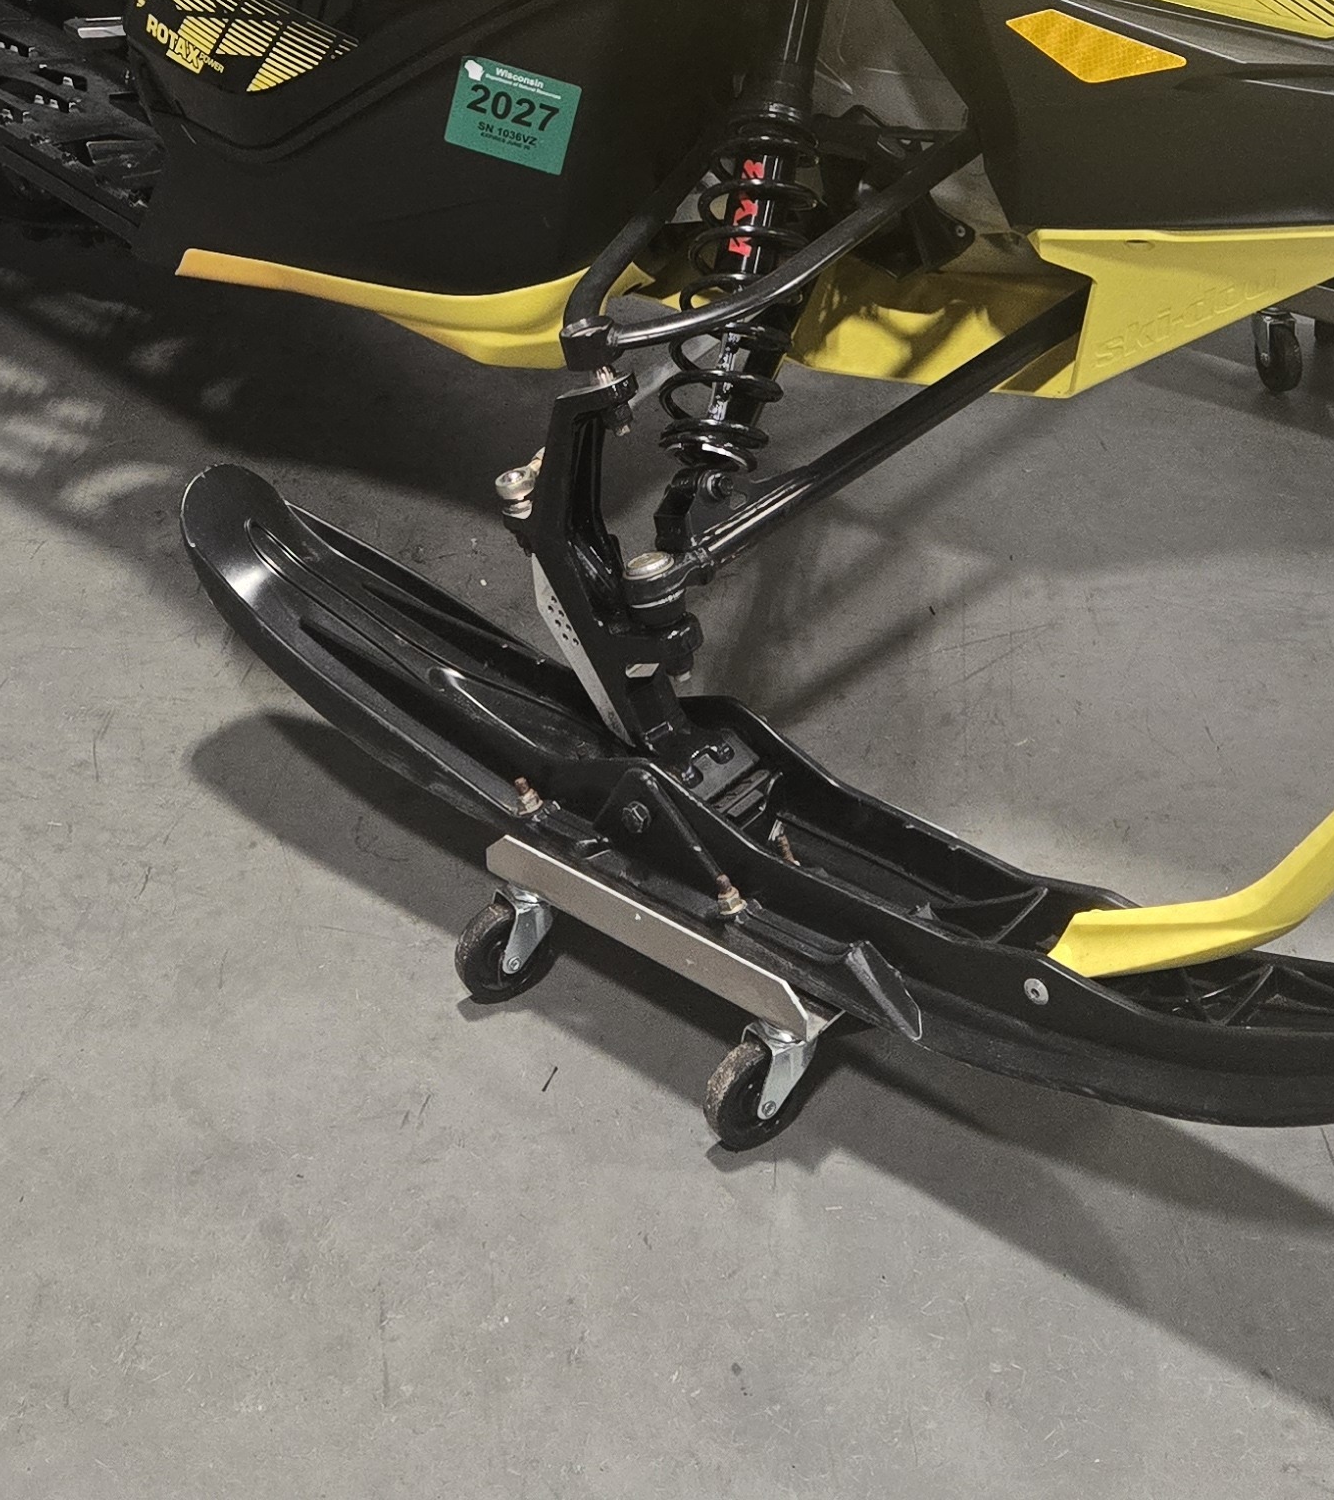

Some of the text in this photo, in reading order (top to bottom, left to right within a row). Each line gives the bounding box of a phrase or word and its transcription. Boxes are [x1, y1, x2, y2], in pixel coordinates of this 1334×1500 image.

[146, 13, 225, 74] ROTAX POWER
[495, 67, 544, 88] Wisconsin
[467, 84, 560, 131] 2027
[477, 121, 494, 133] SN
